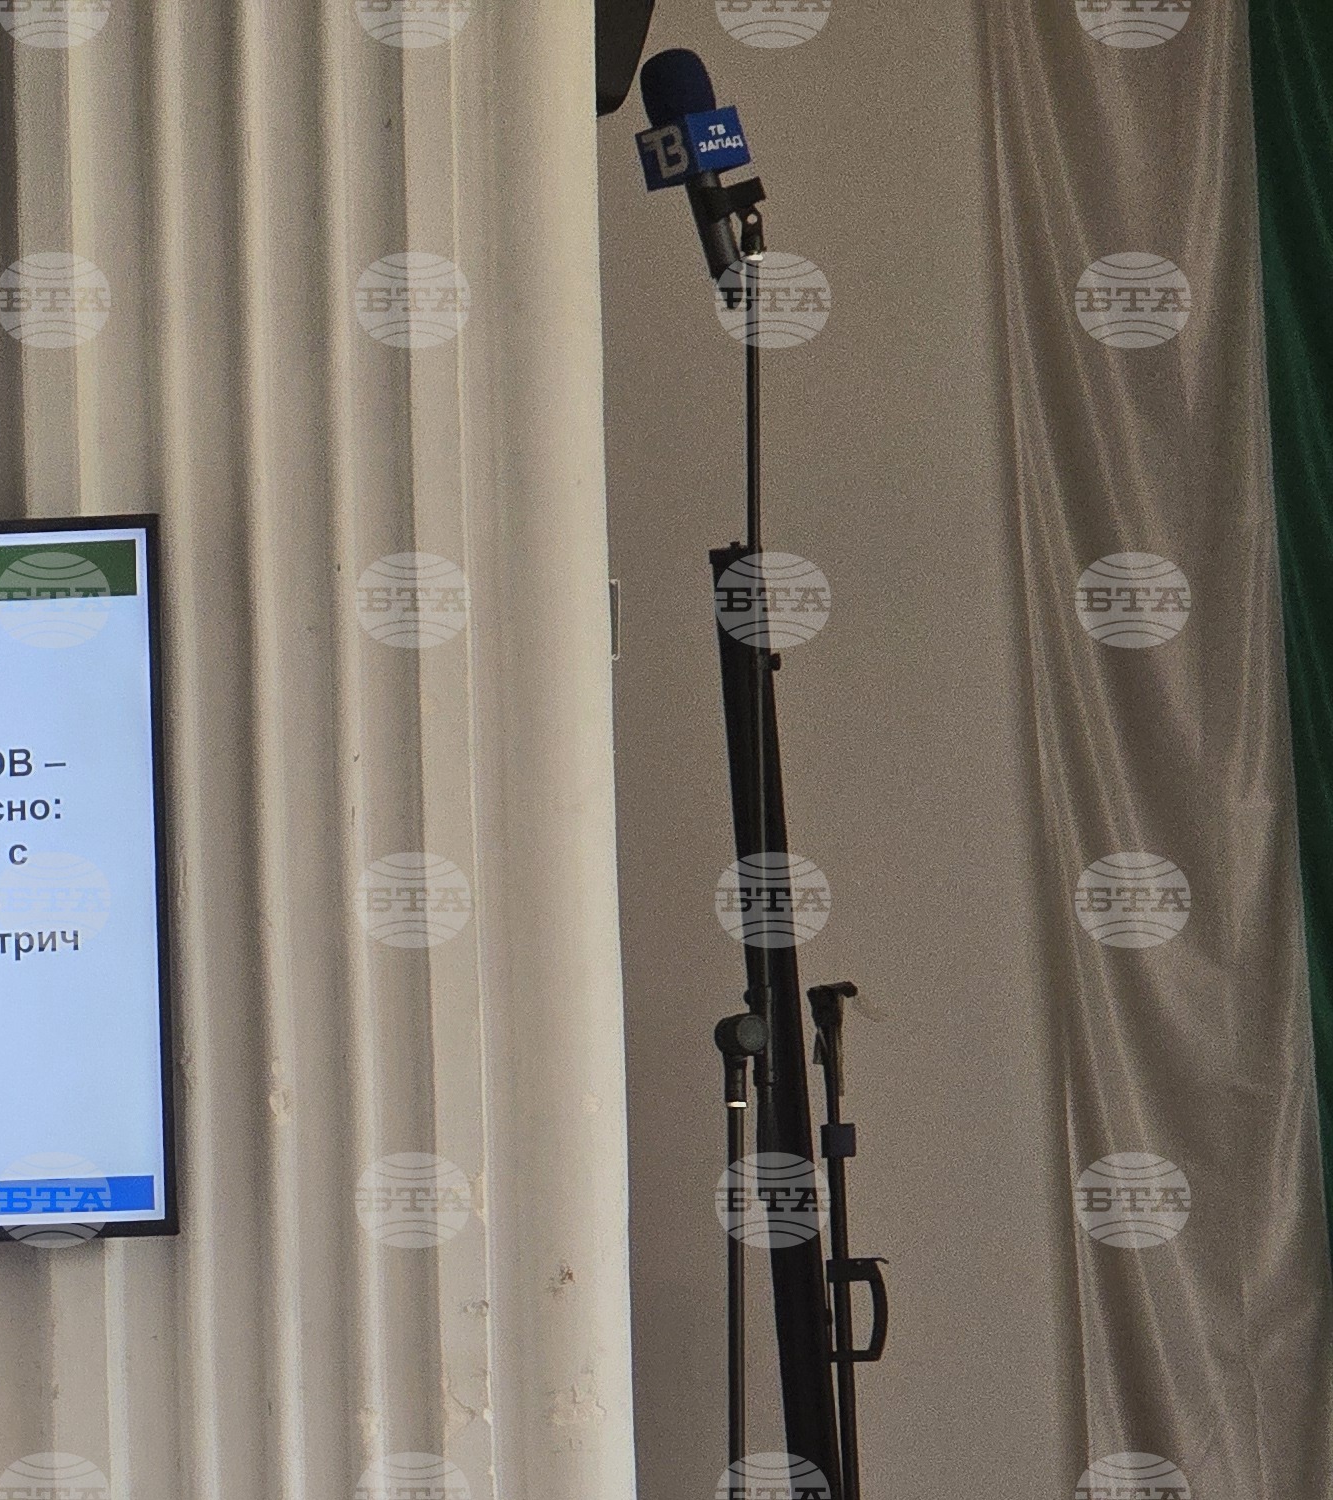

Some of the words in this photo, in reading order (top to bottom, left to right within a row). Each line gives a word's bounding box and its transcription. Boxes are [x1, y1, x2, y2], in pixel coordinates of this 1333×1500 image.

[708, 123, 726, 136] ТВ
[698, 135, 743, 153] ЗАПАД
[9, 844, 28, 865] с
